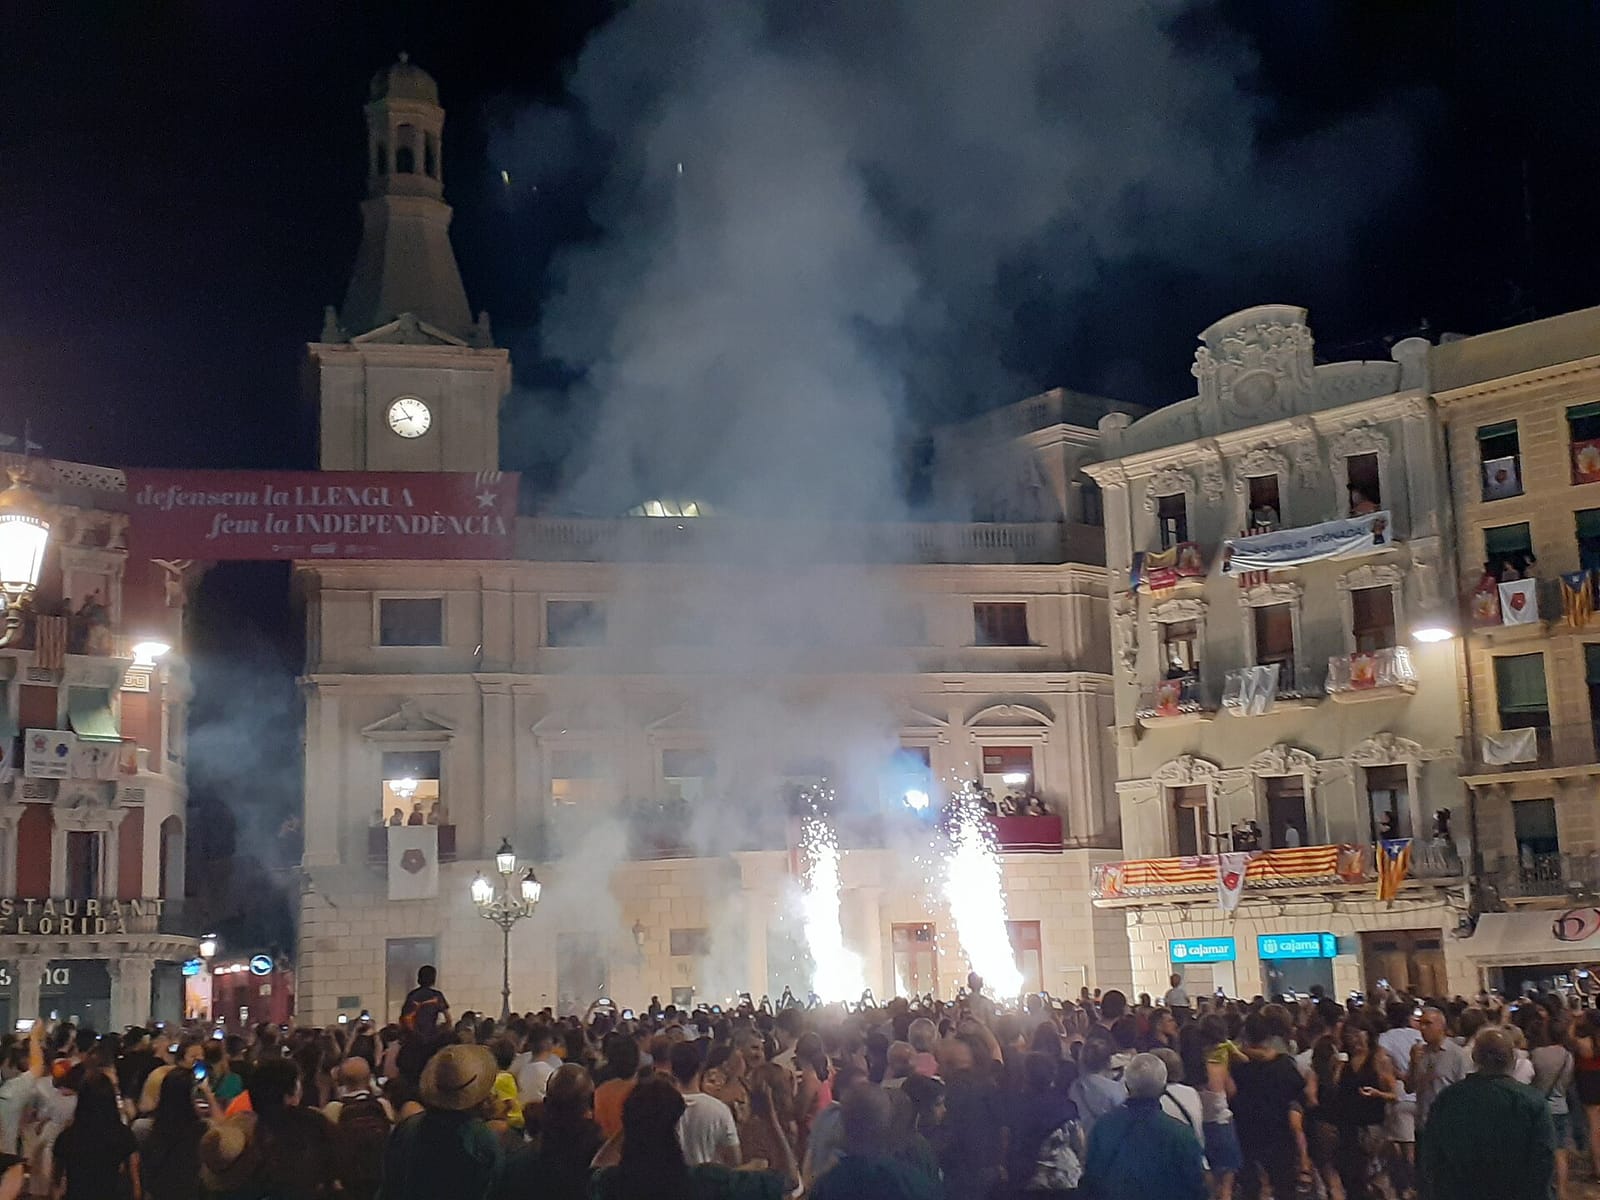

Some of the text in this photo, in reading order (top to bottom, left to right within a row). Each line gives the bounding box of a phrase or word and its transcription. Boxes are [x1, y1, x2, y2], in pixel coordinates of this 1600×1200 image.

[136, 484, 414, 511] defensem la LLENGUA
[205, 511, 506, 540] fem la INDEPENDÈNCIA
[1188, 943, 1230, 957] cajamar
[1279, 939, 1320, 953] cajama
